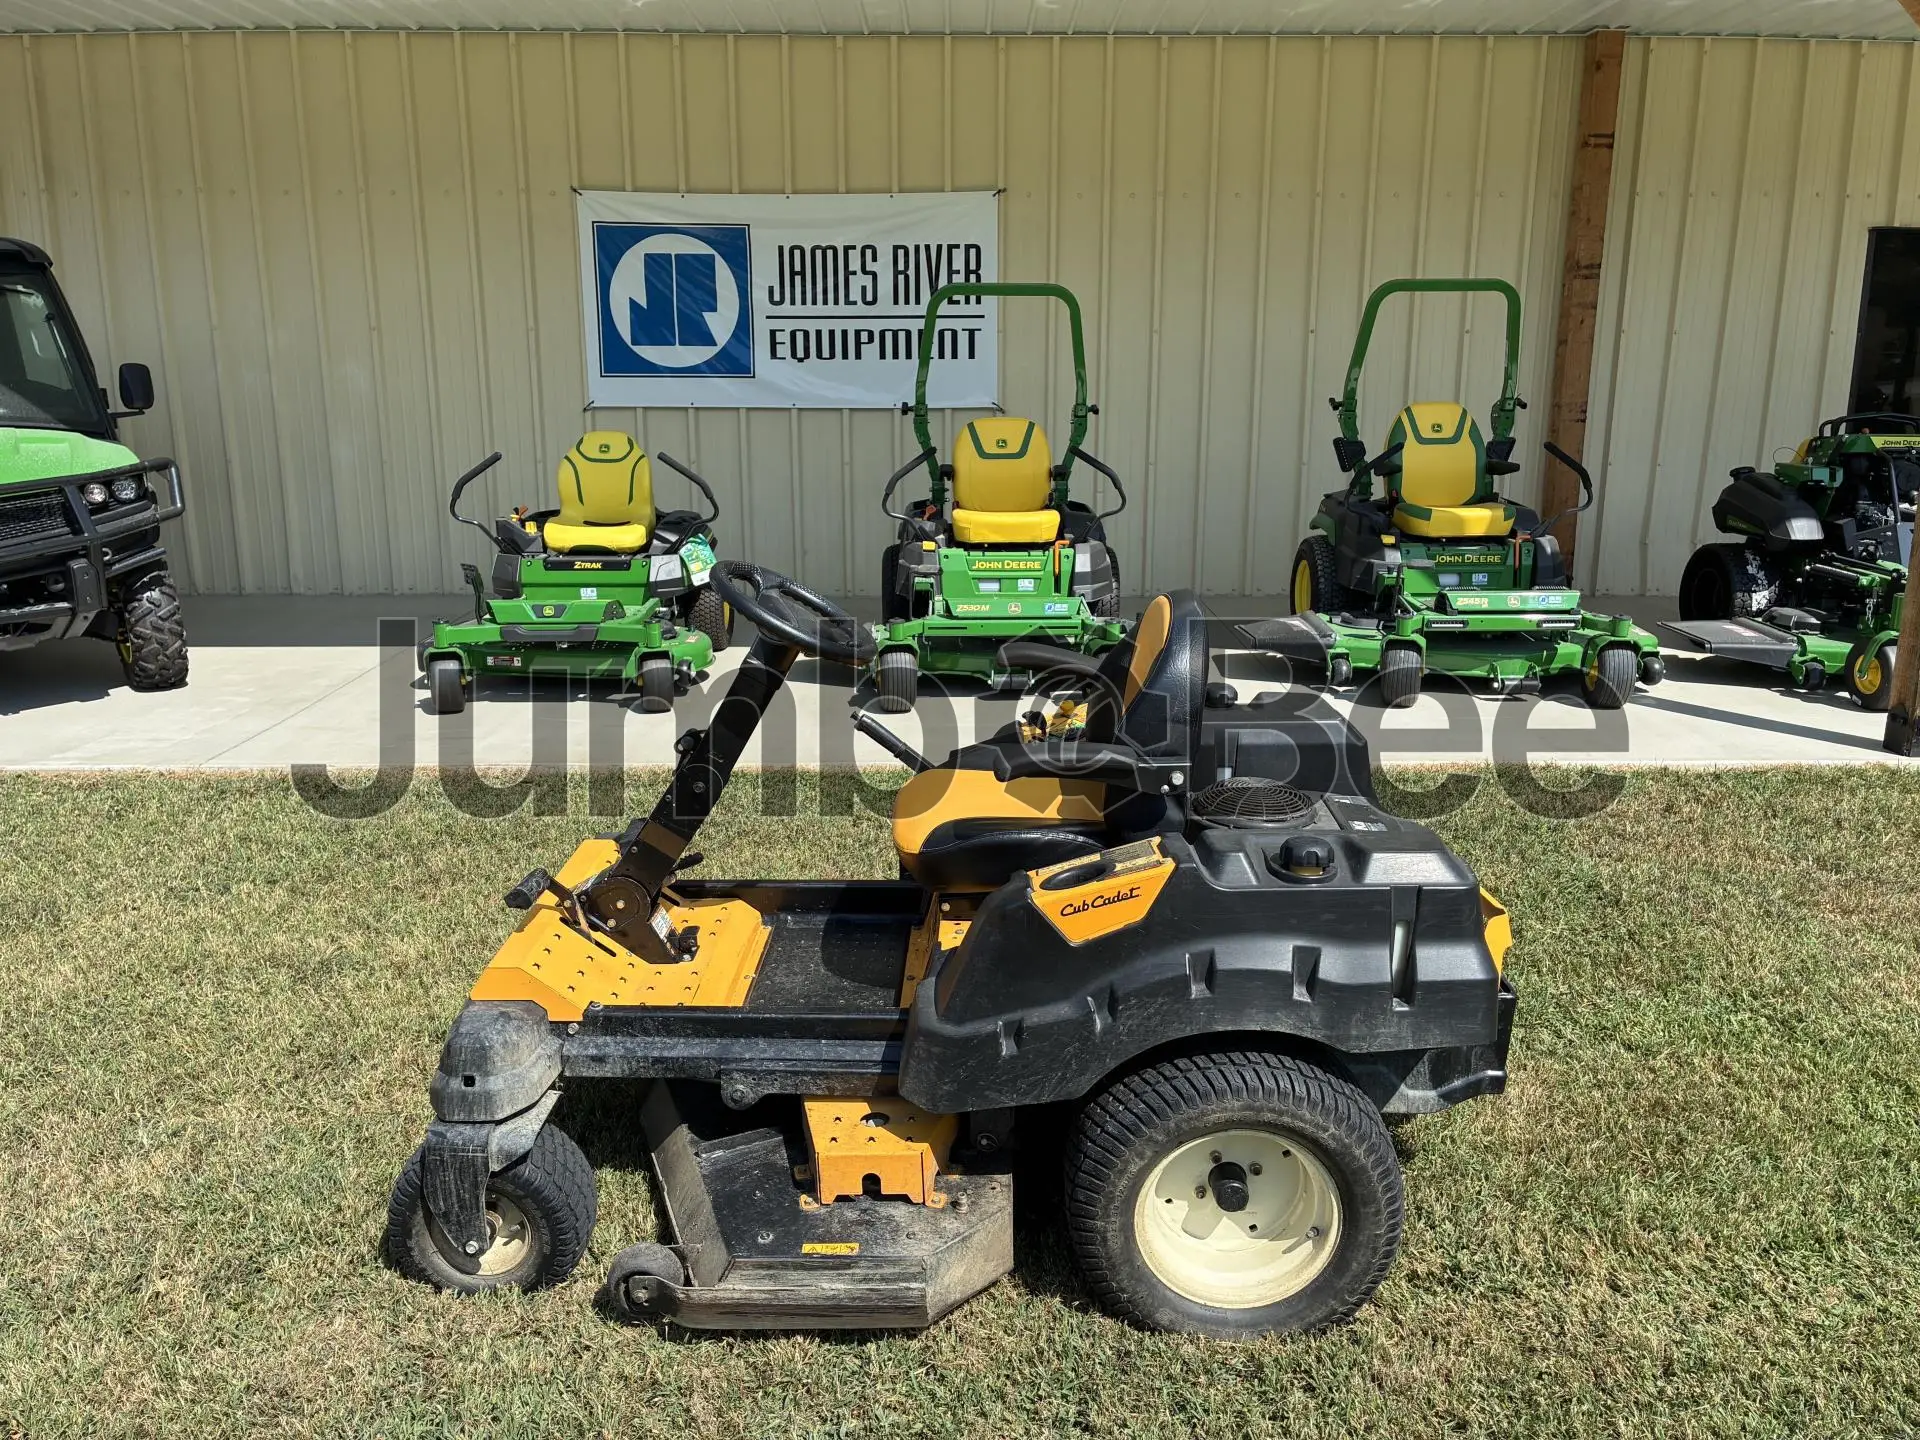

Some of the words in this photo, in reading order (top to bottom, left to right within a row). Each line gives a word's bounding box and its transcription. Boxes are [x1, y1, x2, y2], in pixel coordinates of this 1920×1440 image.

[768, 244, 878, 306] JAMES
[892, 243, 982, 306] RIVER
[972, 560, 1002, 569] JOHN
[1004, 560, 1041, 569] DEERE
[1433, 554, 1462, 564] JOHN
[1464, 554, 1502, 563] DEERE
[1060, 899, 1090, 917] Cub
[1091, 886, 1141, 909] Cadet
